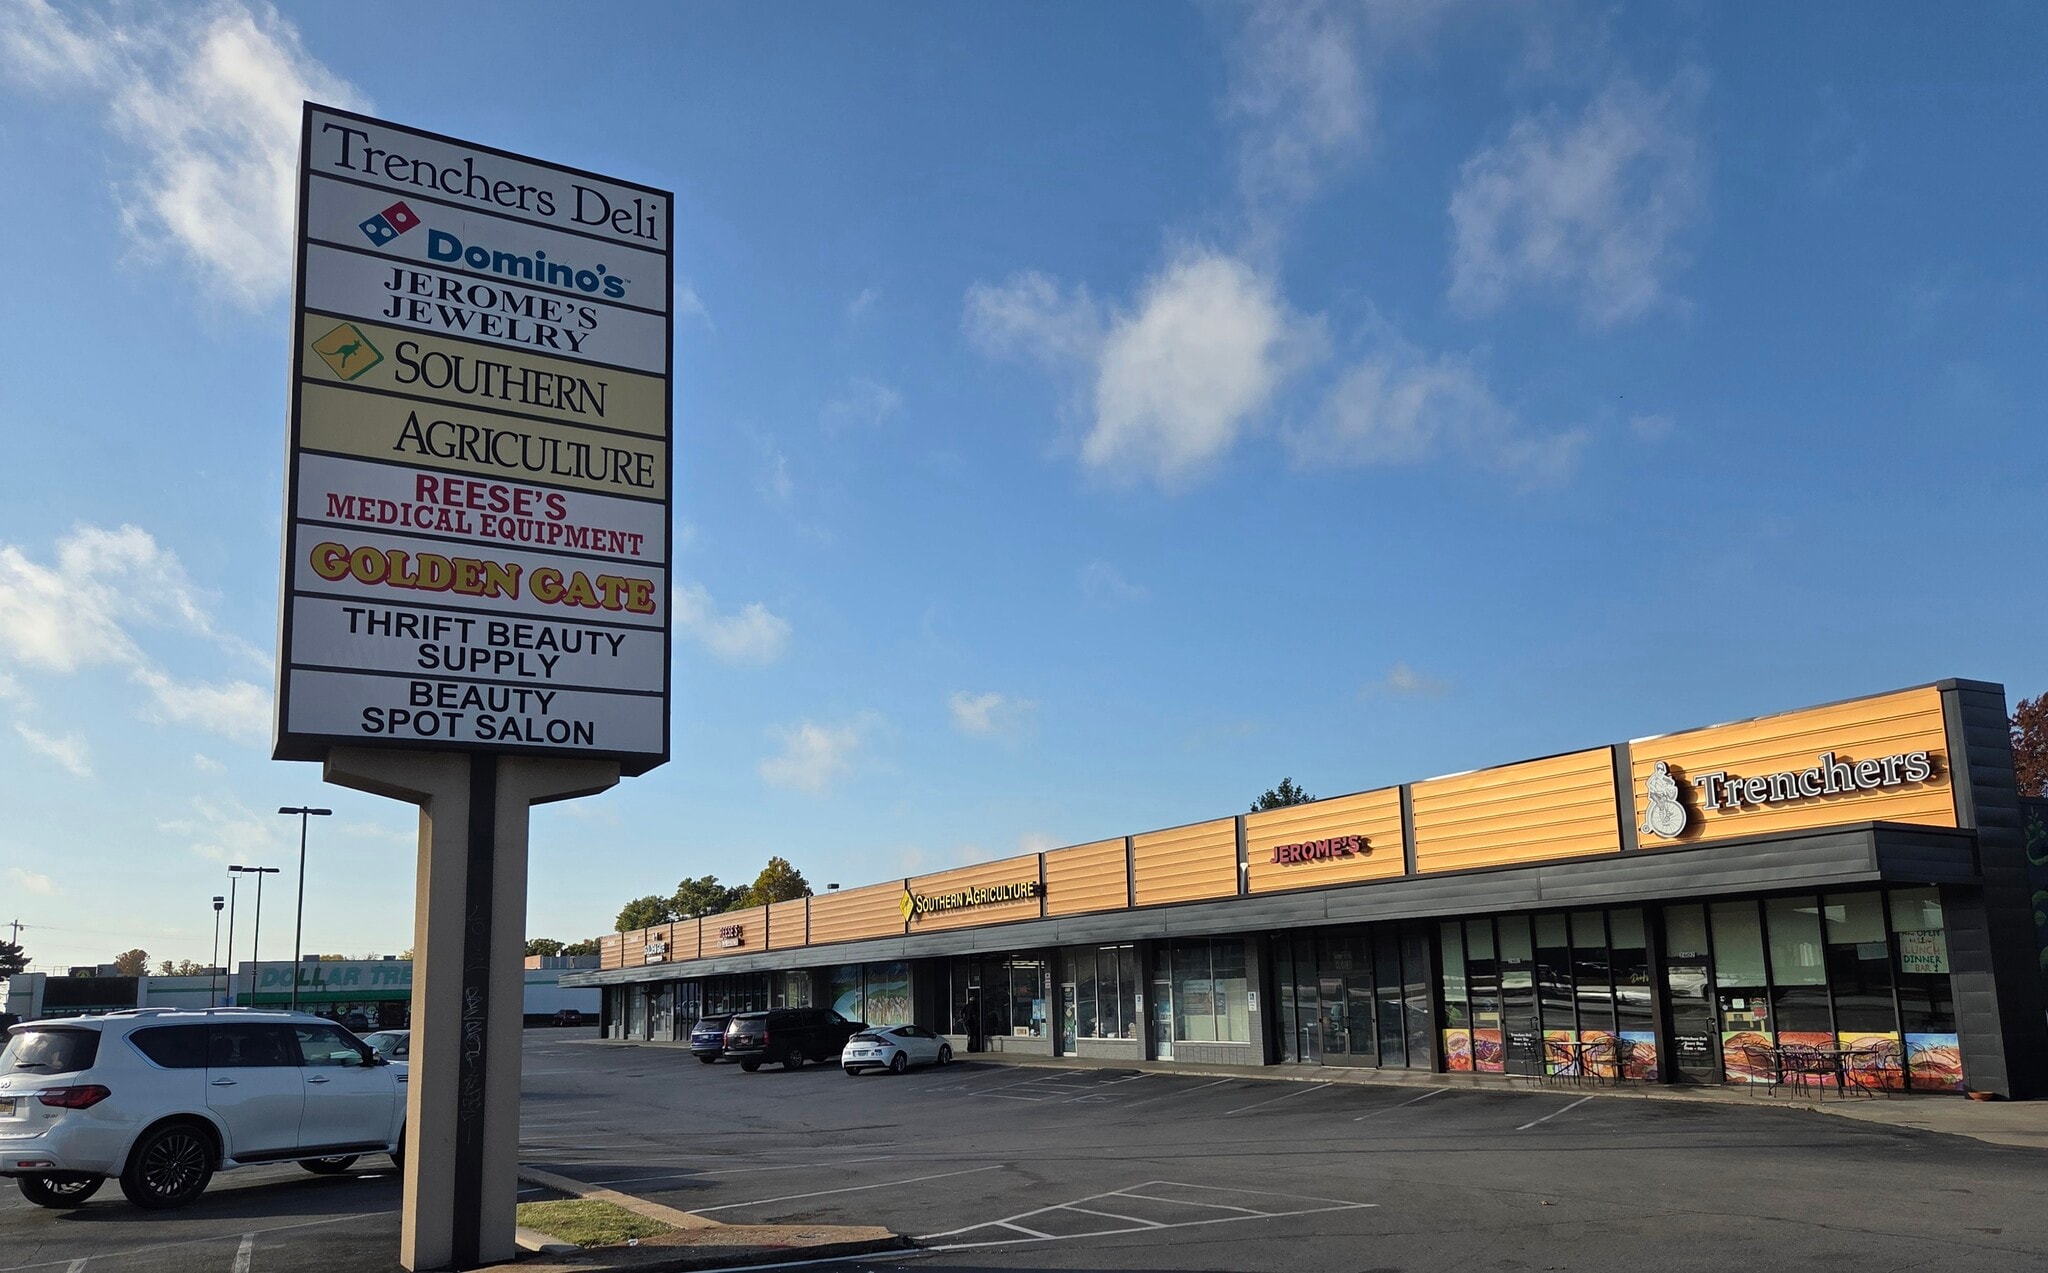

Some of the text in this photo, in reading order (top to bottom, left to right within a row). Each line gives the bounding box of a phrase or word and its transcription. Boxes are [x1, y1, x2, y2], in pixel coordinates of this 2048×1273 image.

[322, 122, 658, 241] Trenchers Deli
[427, 228, 626, 299] Domino's
[383, 267, 598, 330] JEROME'S
[383, 296, 590, 354] JEWELRY
[394, 341, 608, 418] SOUTHERN
[393, 410, 655, 489] AGRICULTURE
[416, 474, 567, 521] REESE'S
[325, 492, 644, 556] MEDICAL EQUIPMENT
[309, 541, 656, 615] GOLDEN GATE
[342, 607, 626, 657] THRIFT BEAUTY
[417, 643, 561, 679] SUPPLY
[409, 681, 557, 715] BEAUTY
[361, 706, 595, 746] SPOT SALON
[1694, 751, 1931, 811] Trenchers
[1270, 834, 1360, 864] JEROME'S
[916, 881, 1035, 914] SOUTHERN AGRICULTURE
[1903, 955, 1942, 964] DINNER
[1904, 945, 1940, 955] LUNCH
[1915, 964, 1931, 972] BAR
[260, 965, 413, 988] DOLLAR TRE
